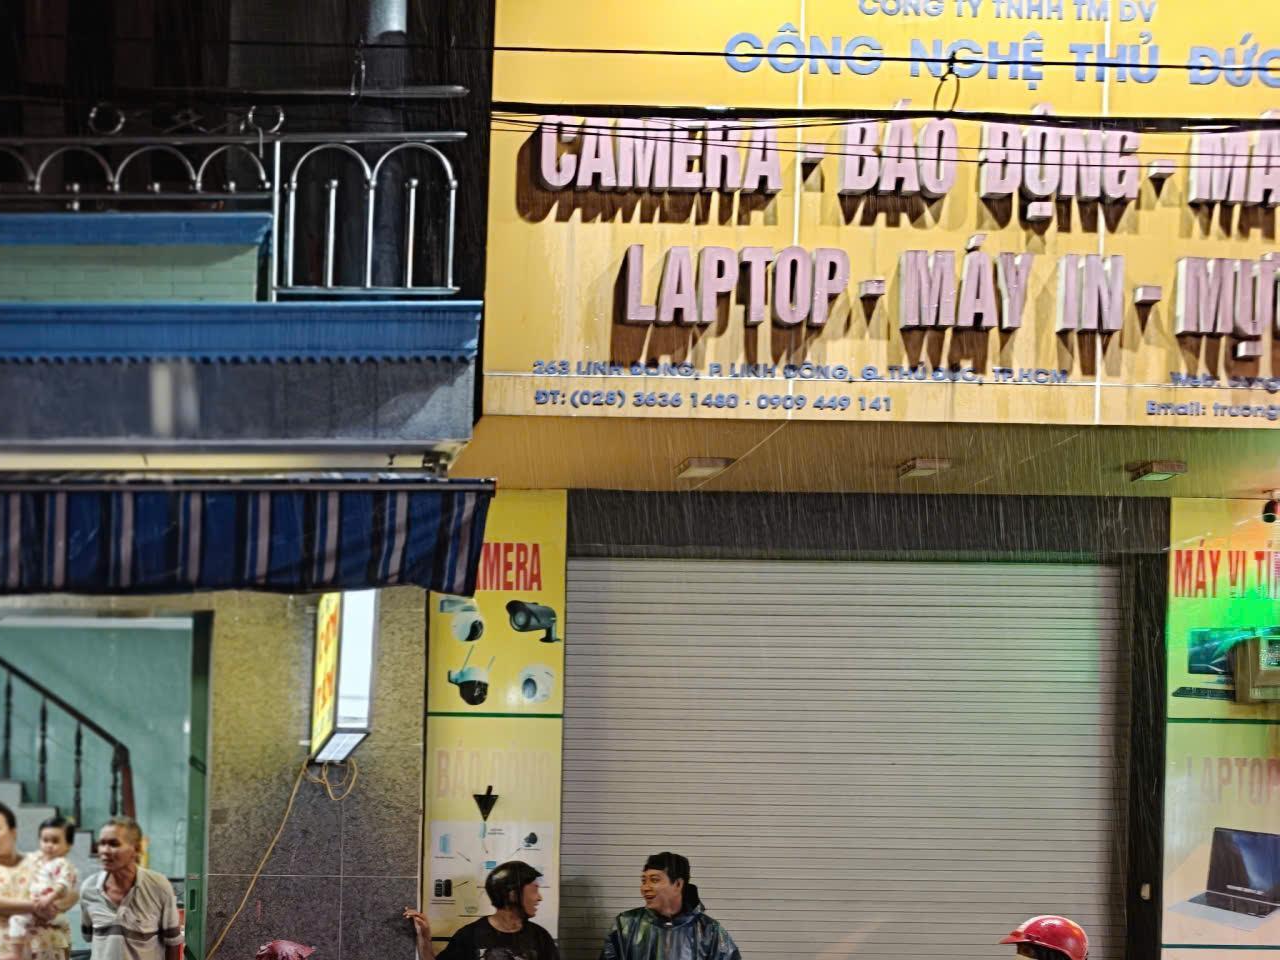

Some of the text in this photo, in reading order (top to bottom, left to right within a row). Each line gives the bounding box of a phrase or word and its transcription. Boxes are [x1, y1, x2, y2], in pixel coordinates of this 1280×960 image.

[954, 0, 990, 18] TY
[993, 0, 1064, 20] TNHH
[1074, 0, 1110, 21] TM
[1119, 0, 1158, 22] DV
[723, 22, 883, 76] CÔNG
[910, 31, 1044, 91] NGHỆ
[1069, 31, 1160, 84] THỦ
[539, 113, 783, 192] CAMERA
[838, 98, 957, 198] BÁO
[977, 103, 1141, 221] ĐỘNG
[624, 243, 851, 327] LAPTOP
[899, 234, 1034, 331] MÁY
[1056, 253, 1124, 333] IN
[1174, 252, 1280, 360] MỰ
[533, 359, 570, 376] 263
[576, 360, 624, 376] LINH
[729, 363, 777, 378] LINH
[993, 366, 1069, 383] TP.HCM
[534, 389, 566, 405] ĐT:
[570, 389, 626, 408] (028)
[632, 391, 683, 408] 3636
[690, 392, 738, 409] 1480
[756, 393, 808, 410] 0909
[812, 395, 851, 412] 449
[857, 396, 892, 412] 141
[1147, 400, 1206, 416] Email:
[475, 542, 542, 591] MERA
[1174, 538, 1221, 598] MÁY
[1227, 550, 1249, 599] VI
